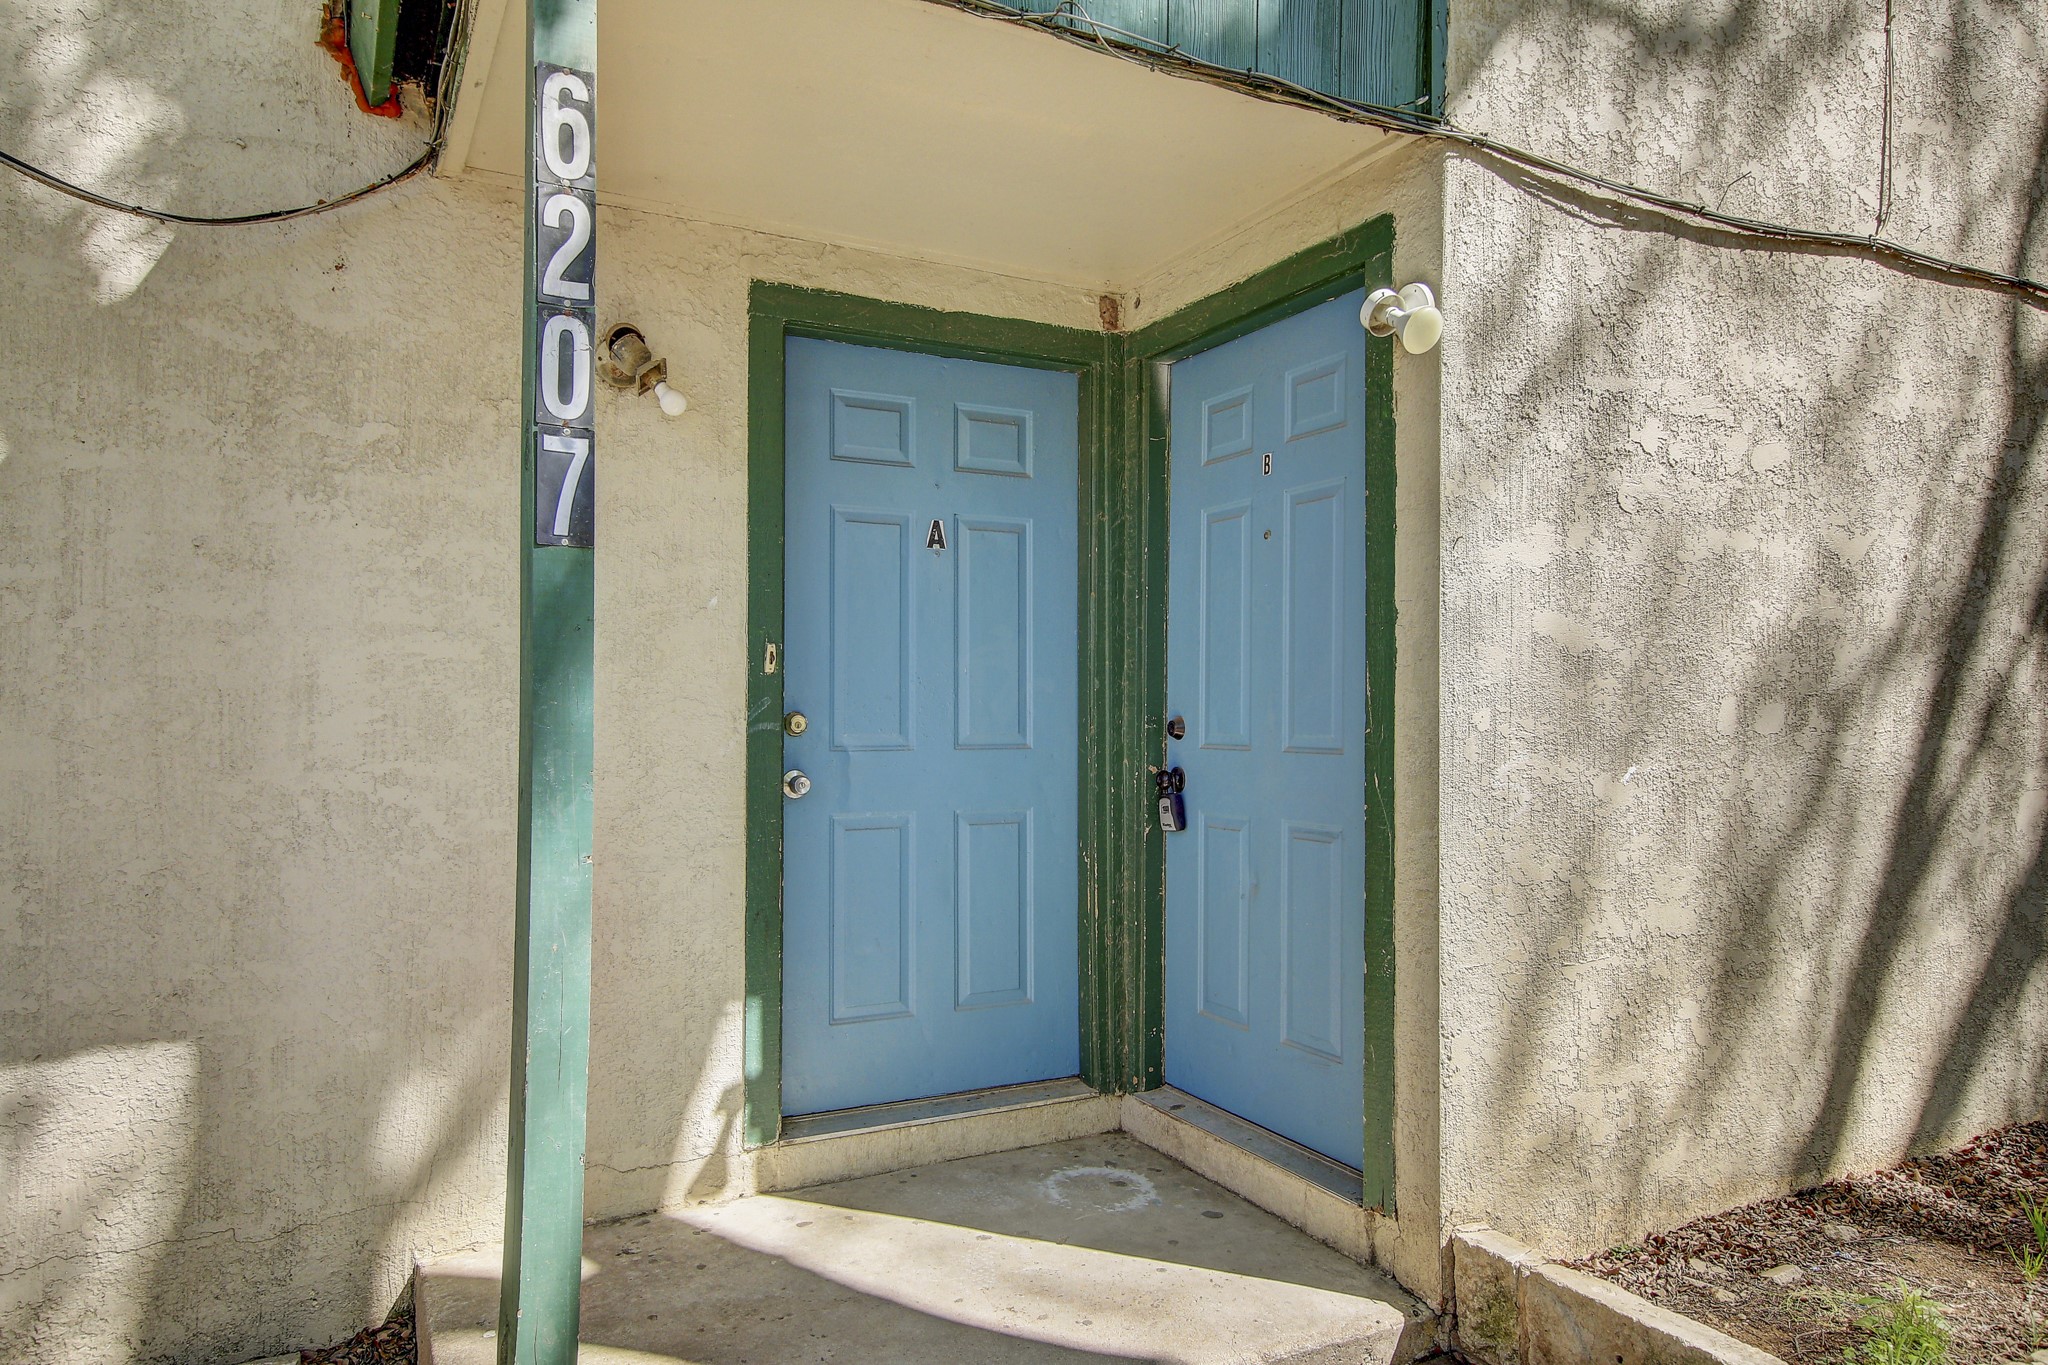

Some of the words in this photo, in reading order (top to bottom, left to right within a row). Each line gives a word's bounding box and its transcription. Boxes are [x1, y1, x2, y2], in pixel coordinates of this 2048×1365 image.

[541, 71, 591, 537] 6207
[1263, 453, 1271, 476] B
[926, 519, 946, 550] A
